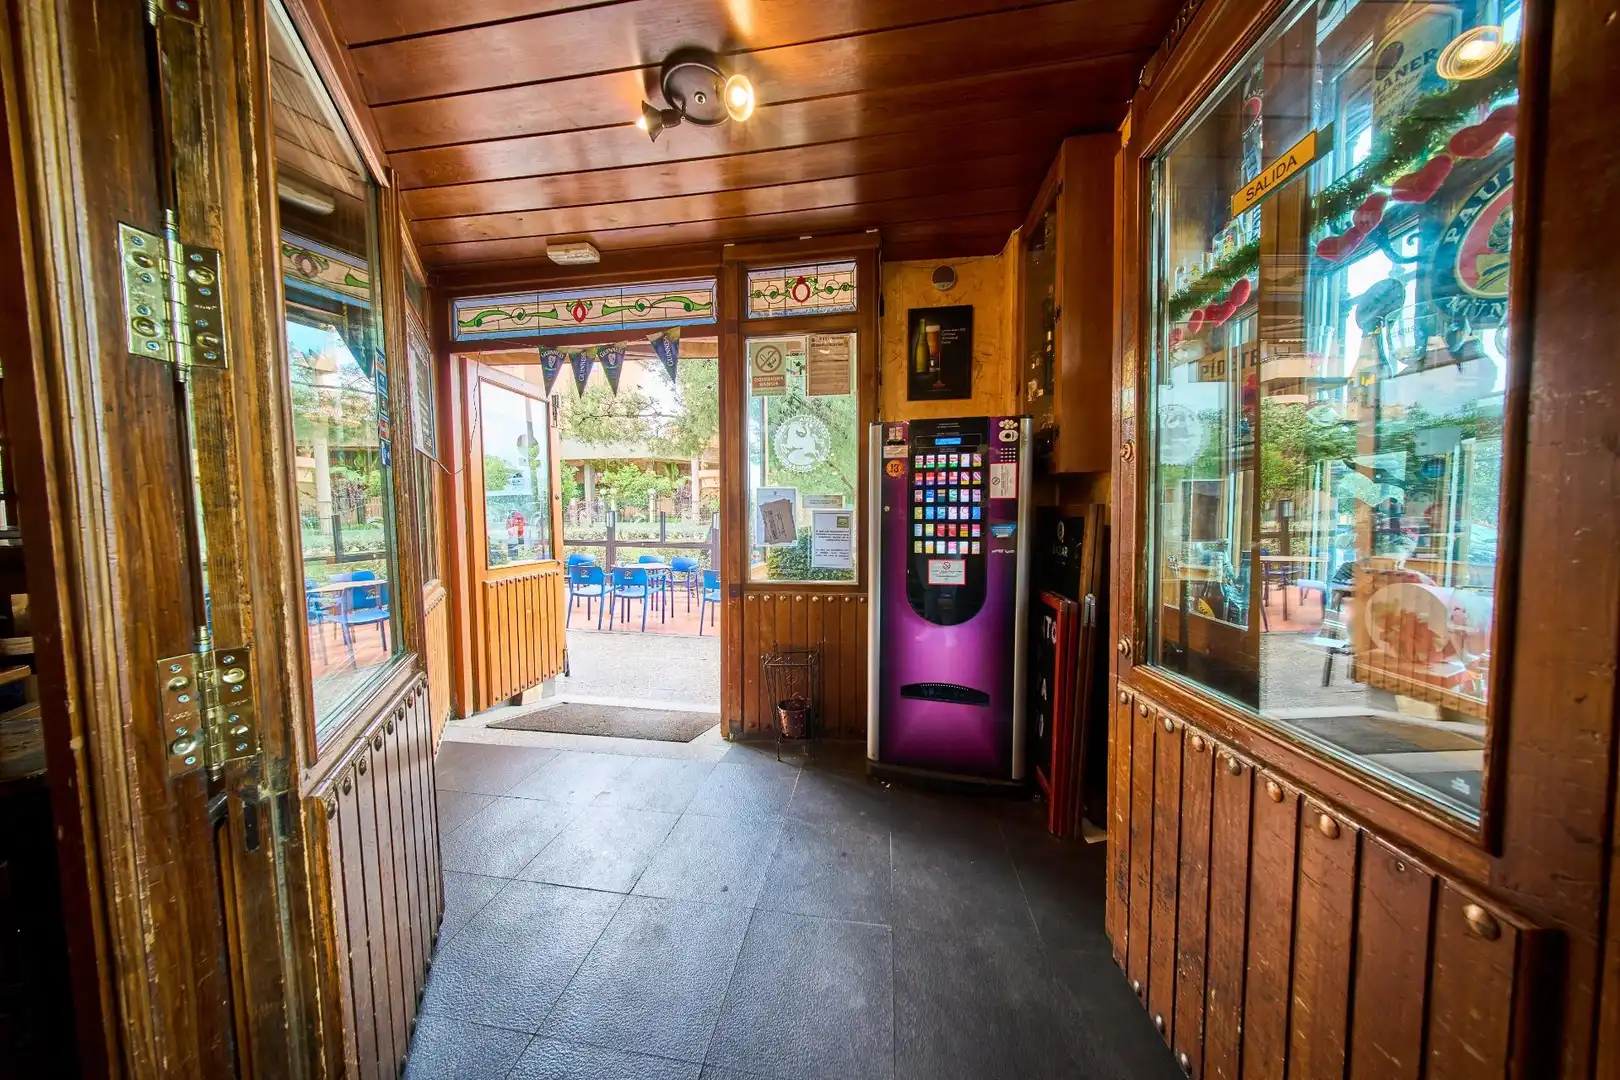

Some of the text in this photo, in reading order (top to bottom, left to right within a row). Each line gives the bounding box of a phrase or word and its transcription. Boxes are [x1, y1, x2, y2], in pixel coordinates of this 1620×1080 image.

[1245, 155, 1297, 202] SALIDA
[541, 349, 565, 359] GUINNESS
[599, 347, 624, 358] GUINNESS
[663, 336, 673, 367] GUINNESS
[578, 352, 588, 382] GUINNESS
